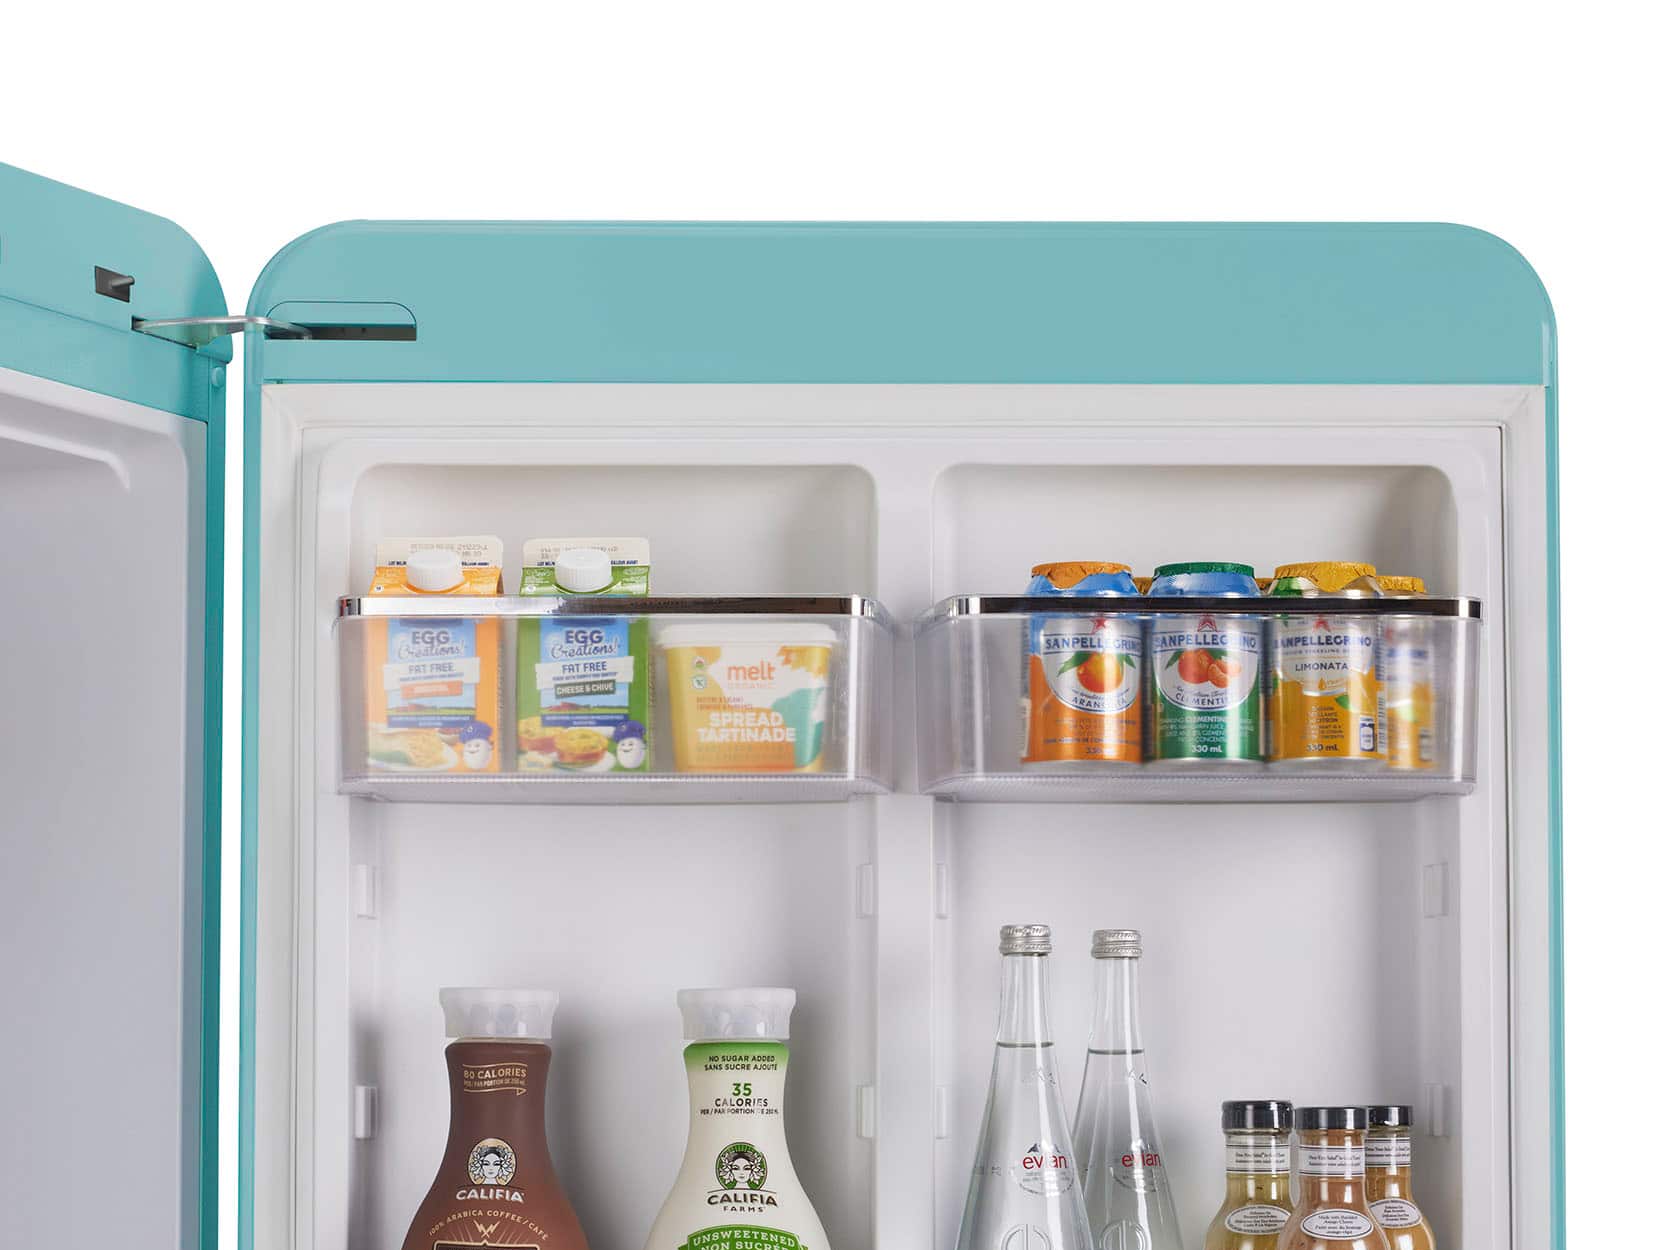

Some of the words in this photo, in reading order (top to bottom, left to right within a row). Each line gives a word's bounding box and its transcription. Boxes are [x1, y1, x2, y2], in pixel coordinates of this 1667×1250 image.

[412, 630, 450, 644] EGG
[565, 630, 603, 644] EGG
[408, 664, 427, 674] FAT
[430, 662, 455, 673] FREE
[562, 663, 582, 674] FAT
[583, 661, 607, 672] FREE
[727, 661, 776, 680] melt
[1295, 662, 1349, 671] LIMONATA
[556, 685, 584, 695] CHEESE
[585, 684, 591, 693] &
[591, 682, 613, 692] CHIVE
[709, 711, 783, 727] SPREAD
[696, 727, 797, 743] TARTINADE
[1191, 744, 1209, 753] 330
[464, 1071, 475, 1079] 80
[477, 1068, 527, 1079] CALORIES
[725, 1063, 750, 1071] SUCRE
[732, 1083, 752, 1097] 35
[715, 1098, 768, 1107] CALORIES
[1022, 1152, 1068, 1170] evan
[456, 1188, 524, 1203] CALIFIA
[707, 1193, 779, 1207] CALIFIA
[429, 1220, 445, 1236] 100%
[446, 1209, 484, 1223] ARABICA
[693, 1230, 795, 1248] UNSWEETENED
